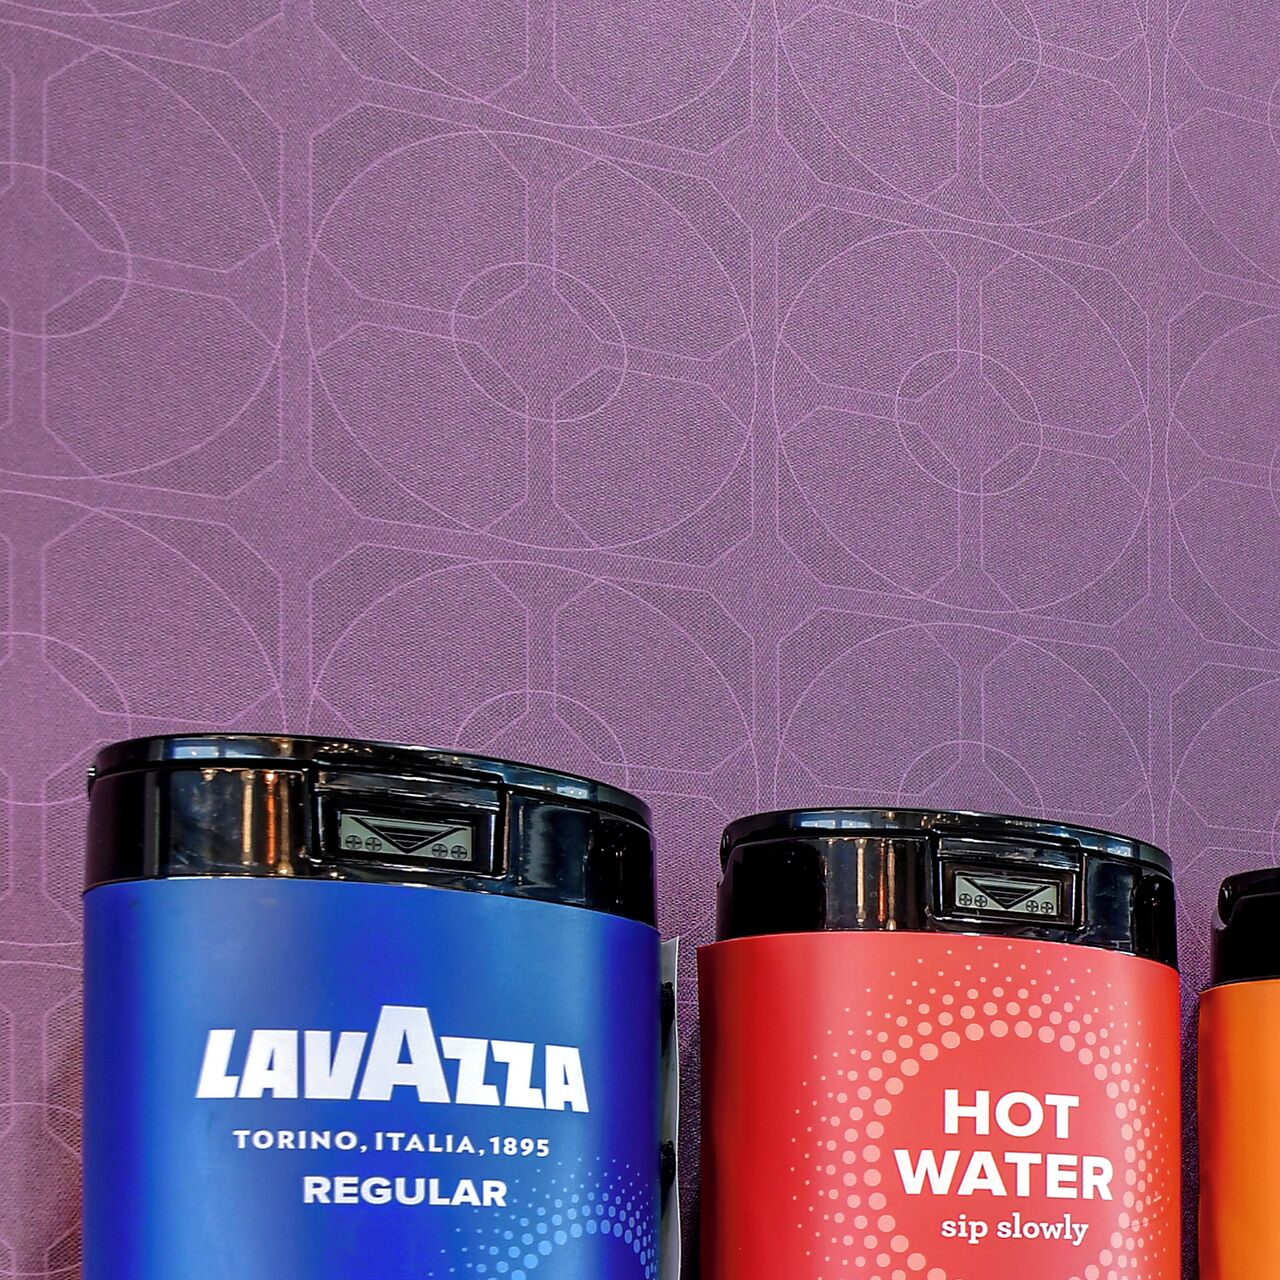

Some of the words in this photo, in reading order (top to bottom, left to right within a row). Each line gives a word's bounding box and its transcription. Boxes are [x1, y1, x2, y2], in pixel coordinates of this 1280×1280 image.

[196, 1005, 590, 1113] LAVAZZA
[944, 1089, 1080, 1139] HOT
[232, 1129, 367, 1153] TORINO,
[489, 1136, 550, 1157] 1895
[303, 1176, 507, 1207] REGULAR
[894, 1149, 1114, 1201] WATER
[941, 1214, 988, 1244] sip
[997, 1212, 1089, 1246] slowly
